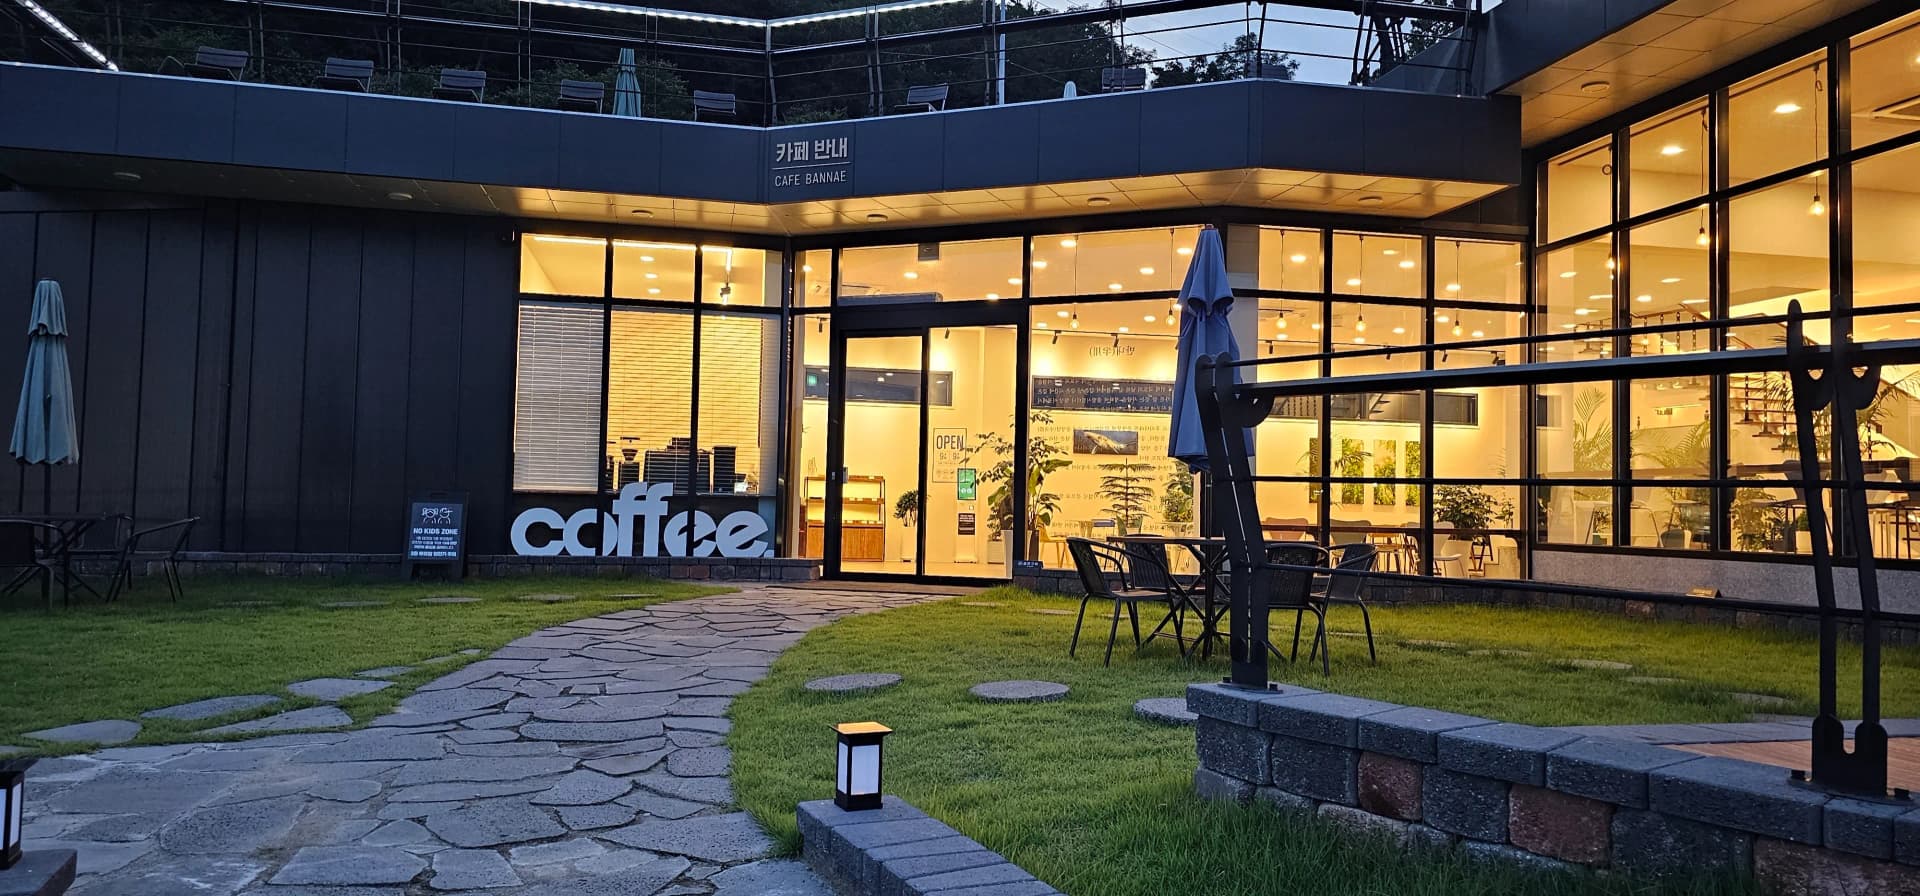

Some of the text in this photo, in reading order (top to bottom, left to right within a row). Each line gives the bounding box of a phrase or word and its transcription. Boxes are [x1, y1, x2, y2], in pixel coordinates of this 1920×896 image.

[776, 137, 848, 162] 카페 반내
[774, 170, 847, 187] CAFE BANNAE
[936, 434, 964, 450] OPEN
